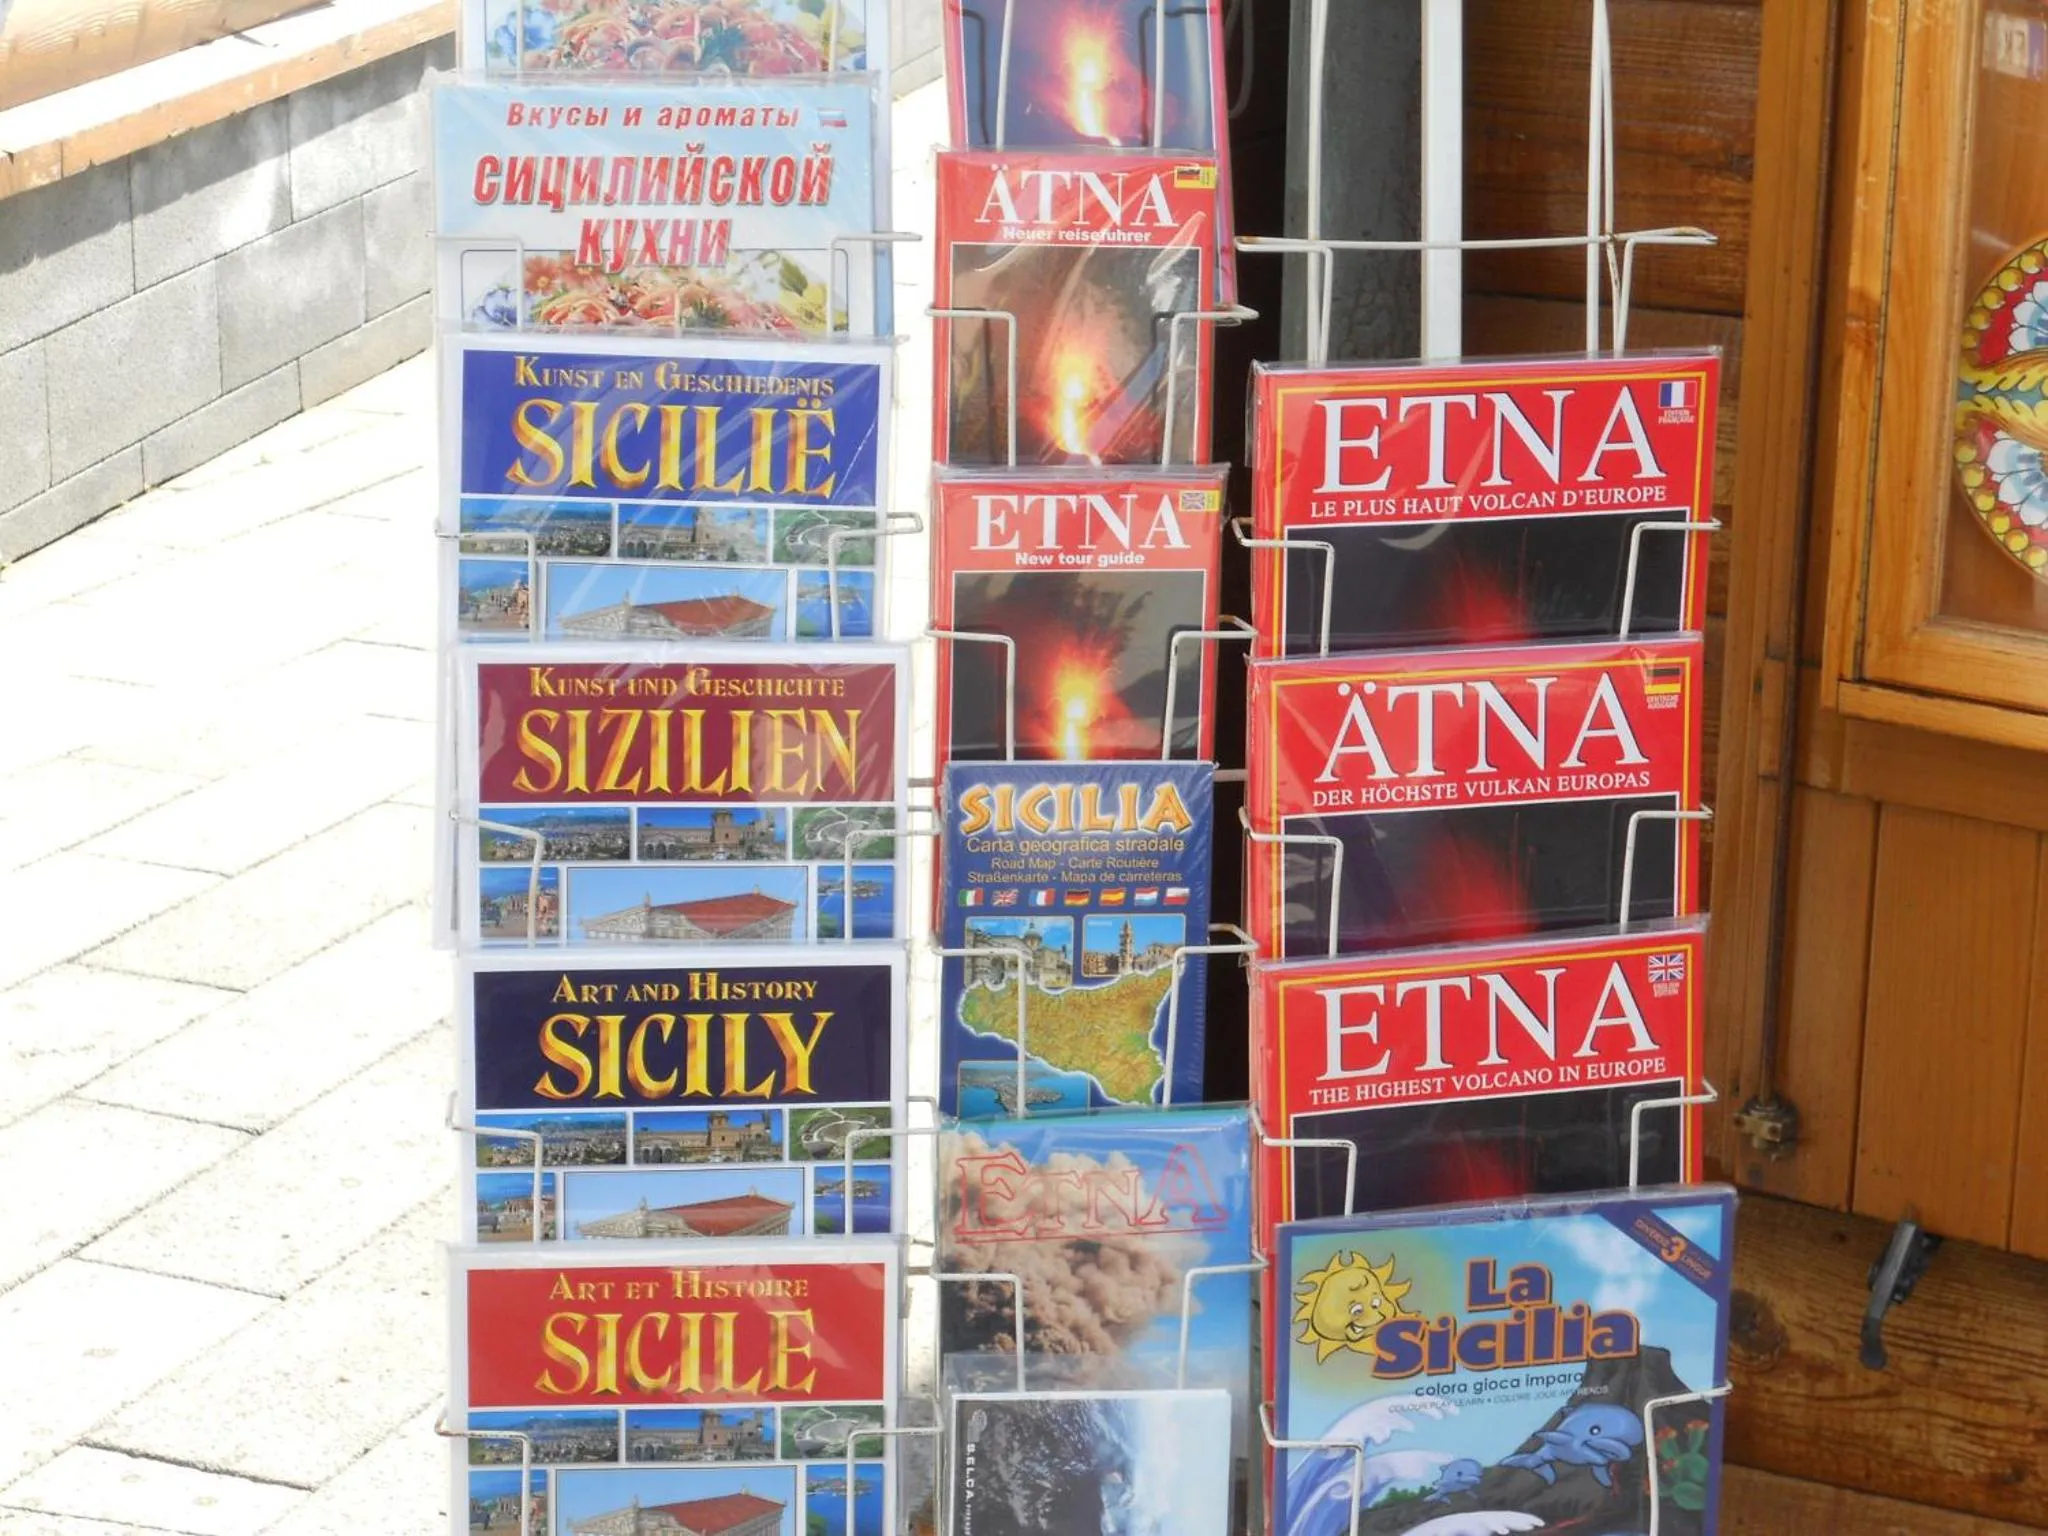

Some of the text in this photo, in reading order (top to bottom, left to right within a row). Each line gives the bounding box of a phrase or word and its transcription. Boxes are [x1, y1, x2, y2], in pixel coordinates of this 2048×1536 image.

[506, 102, 799, 131] Вкусы и ароматы
[472, 142, 835, 212] СИЦИЛИЙСКОЙ
[974, 164, 1180, 228] ÄTNA
[575, 217, 733, 274] КУХНИ
[1002, 226, 1052, 241] Neuer
[513, 355, 605, 389] KUNST
[505, 397, 837, 500] SICILIË
[1312, 385, 1667, 495] ETNA
[969, 493, 1192, 551] ETNA
[1310, 485, 1667, 518] LE PLUS HAUT VOLCAN D'EUROPE
[1015, 551, 1146, 569] New tour guide
[528, 666, 846, 698] KUNST UND GESCHICHTE
[512, 707, 863, 796] SIZILIEN
[1313, 671, 1651, 784] ÄTNA
[959, 782, 1194, 836] SICILIA
[1312, 771, 1651, 807] DER HÖCHSTE VULKAN EUROPAS
[966, 836, 1186, 856] Carta geografica stradale
[991, 856, 1025, 869] Road
[1029, 856, 1057, 871] Map
[1068, 856, 1102, 869] Carte
[1060, 871, 1096, 884] Mapa
[1100, 871, 1115, 882] de
[1118, 871, 1183, 883] carreteras
[552, 972, 819, 1004] ART AND HISTORY
[1315, 960, 1661, 1082] ETNA
[533, 1011, 835, 1100] SICILY
[1309, 1056, 1667, 1106] THE HIGHEST VOLCANO IN EUROPE
[1660, 1234, 1687, 1264] 3
[549, 1269, 809, 1302] ART ET HISTOIRE
[1466, 1257, 1553, 1313] La
[534, 1308, 819, 1397] SICILE
[1371, 1302, 1641, 1380] Sicilia
[1415, 1372, 1583, 1397] colora gioca impara
